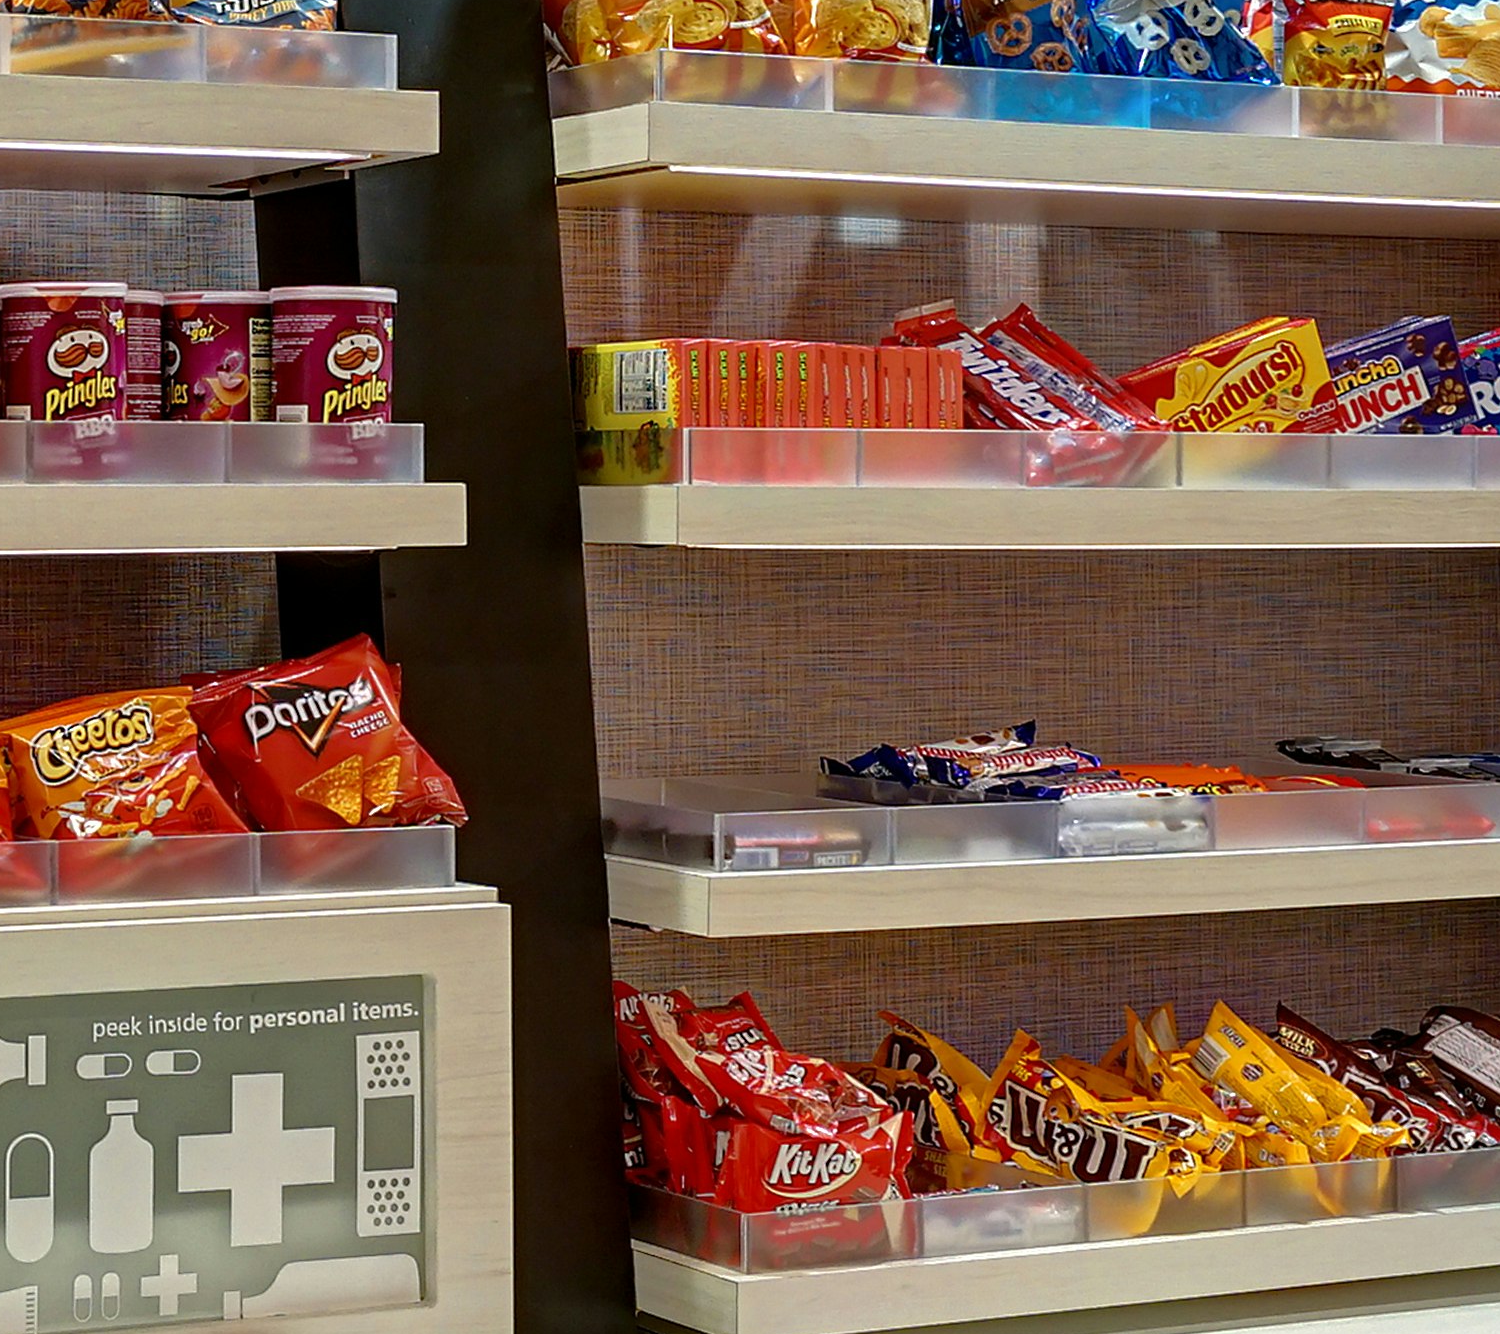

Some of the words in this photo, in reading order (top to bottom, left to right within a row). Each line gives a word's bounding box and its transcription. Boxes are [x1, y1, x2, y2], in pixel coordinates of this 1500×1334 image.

[46, 374, 117, 421] Pringles
[323, 374, 387, 423] Pringles
[1172, 340, 1302, 432] Starburst
[74, 415, 117, 441] BBQ
[31, 701, 155, 786] Cheetos
[244, 679, 375, 763] Doritos
[92, 1016, 143, 1043] peek
[148, 1013, 208, 1035] inside
[212, 1011, 244, 1032] for
[250, 1002, 346, 1034] personal
[351, 1000, 420, 1021] items.
[769, 1142, 861, 1185] KitKat
